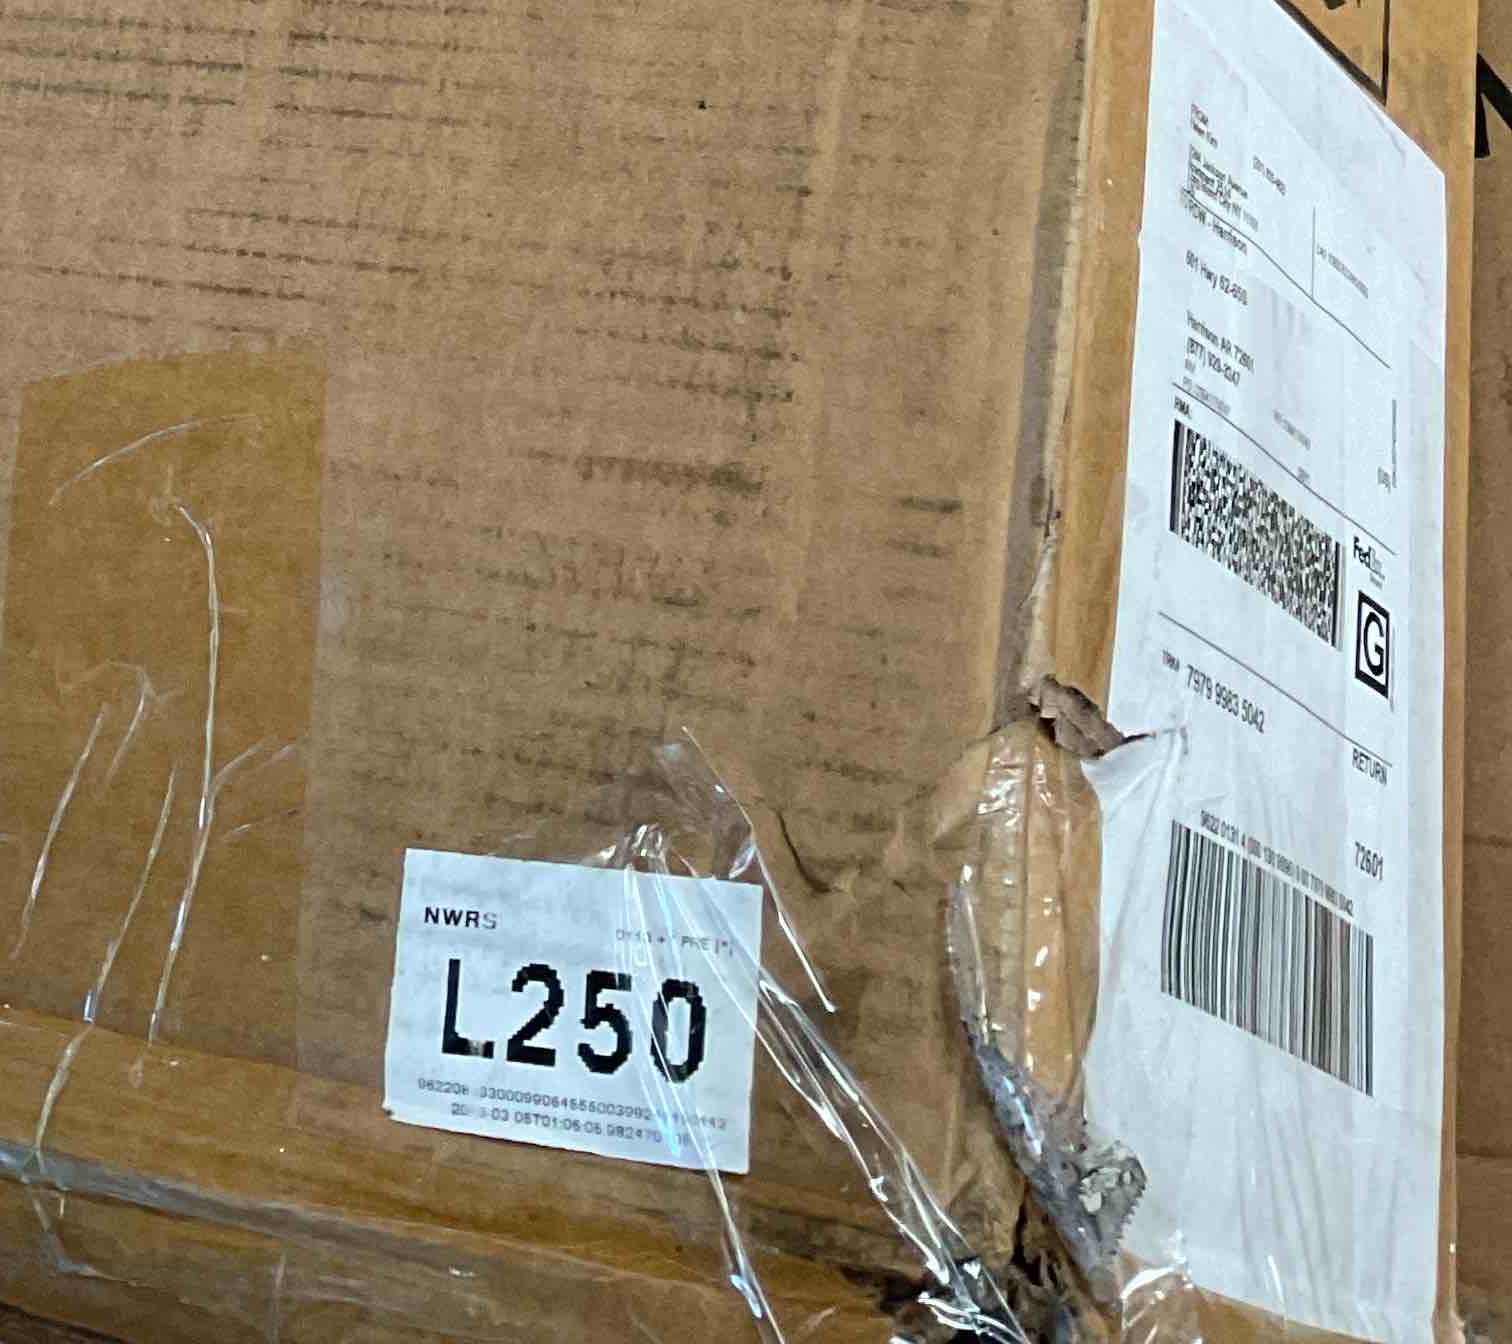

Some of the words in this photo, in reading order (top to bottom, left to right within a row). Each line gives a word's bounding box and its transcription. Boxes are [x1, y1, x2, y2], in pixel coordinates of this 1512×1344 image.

[1363, 612, 1384, 676] G
[1355, 841, 1384, 880] 72601
[442, 958, 707, 1085] L250
